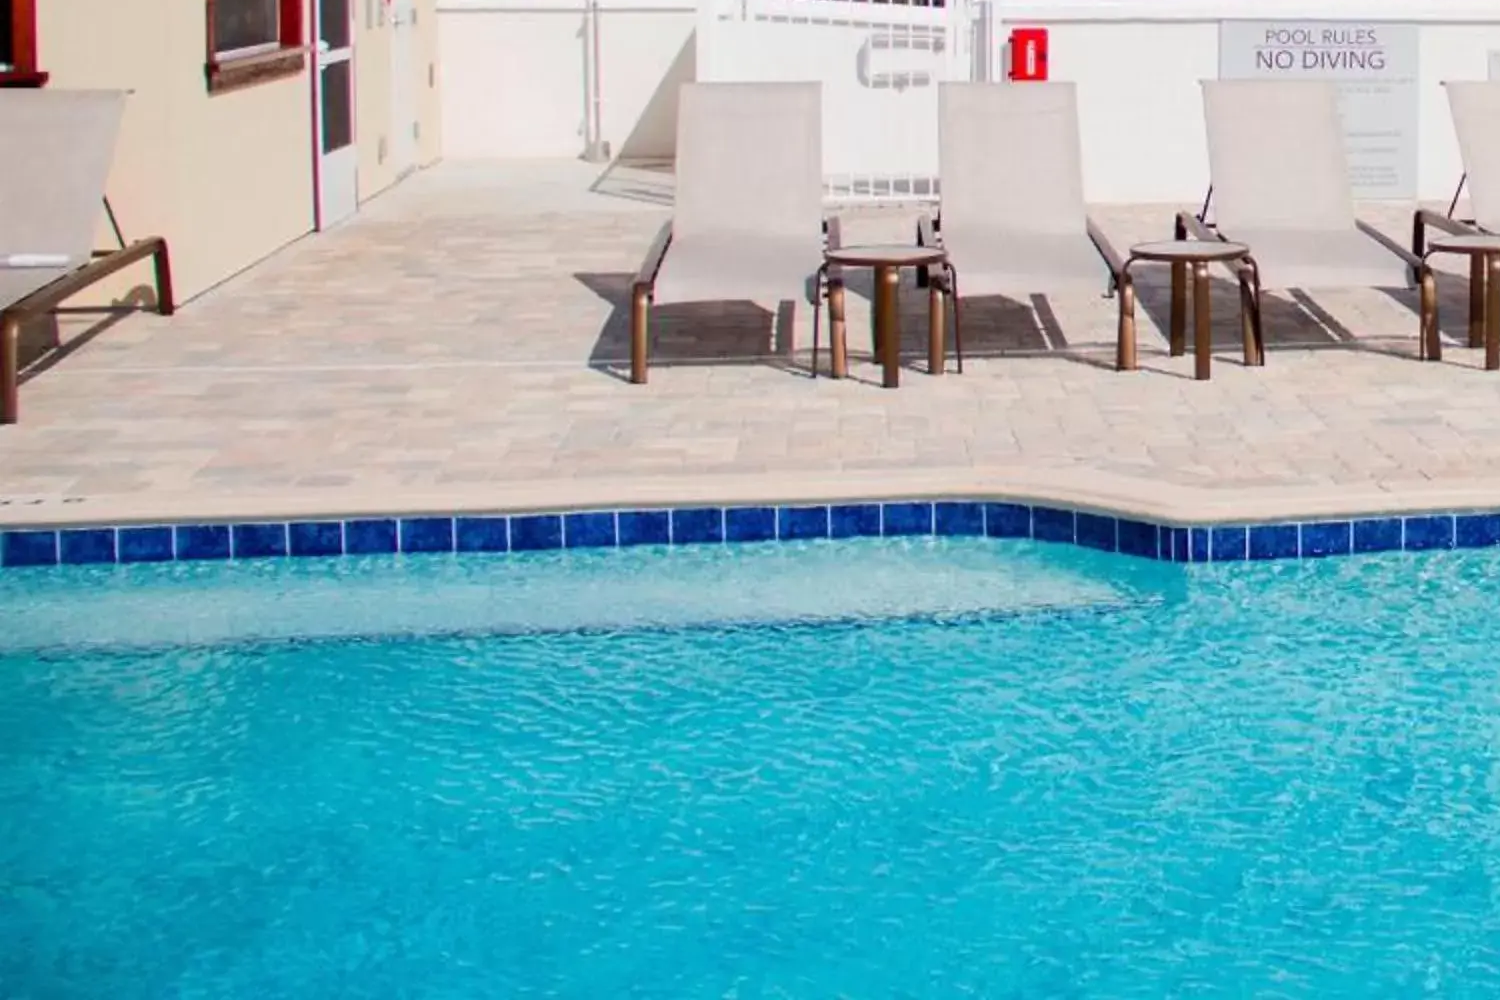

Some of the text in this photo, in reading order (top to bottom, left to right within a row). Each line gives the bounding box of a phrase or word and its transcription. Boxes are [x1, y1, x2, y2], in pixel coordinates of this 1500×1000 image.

[1265, 29, 1377, 45] POOL RULES
[1256, 50, 1386, 70] NO DIVING
